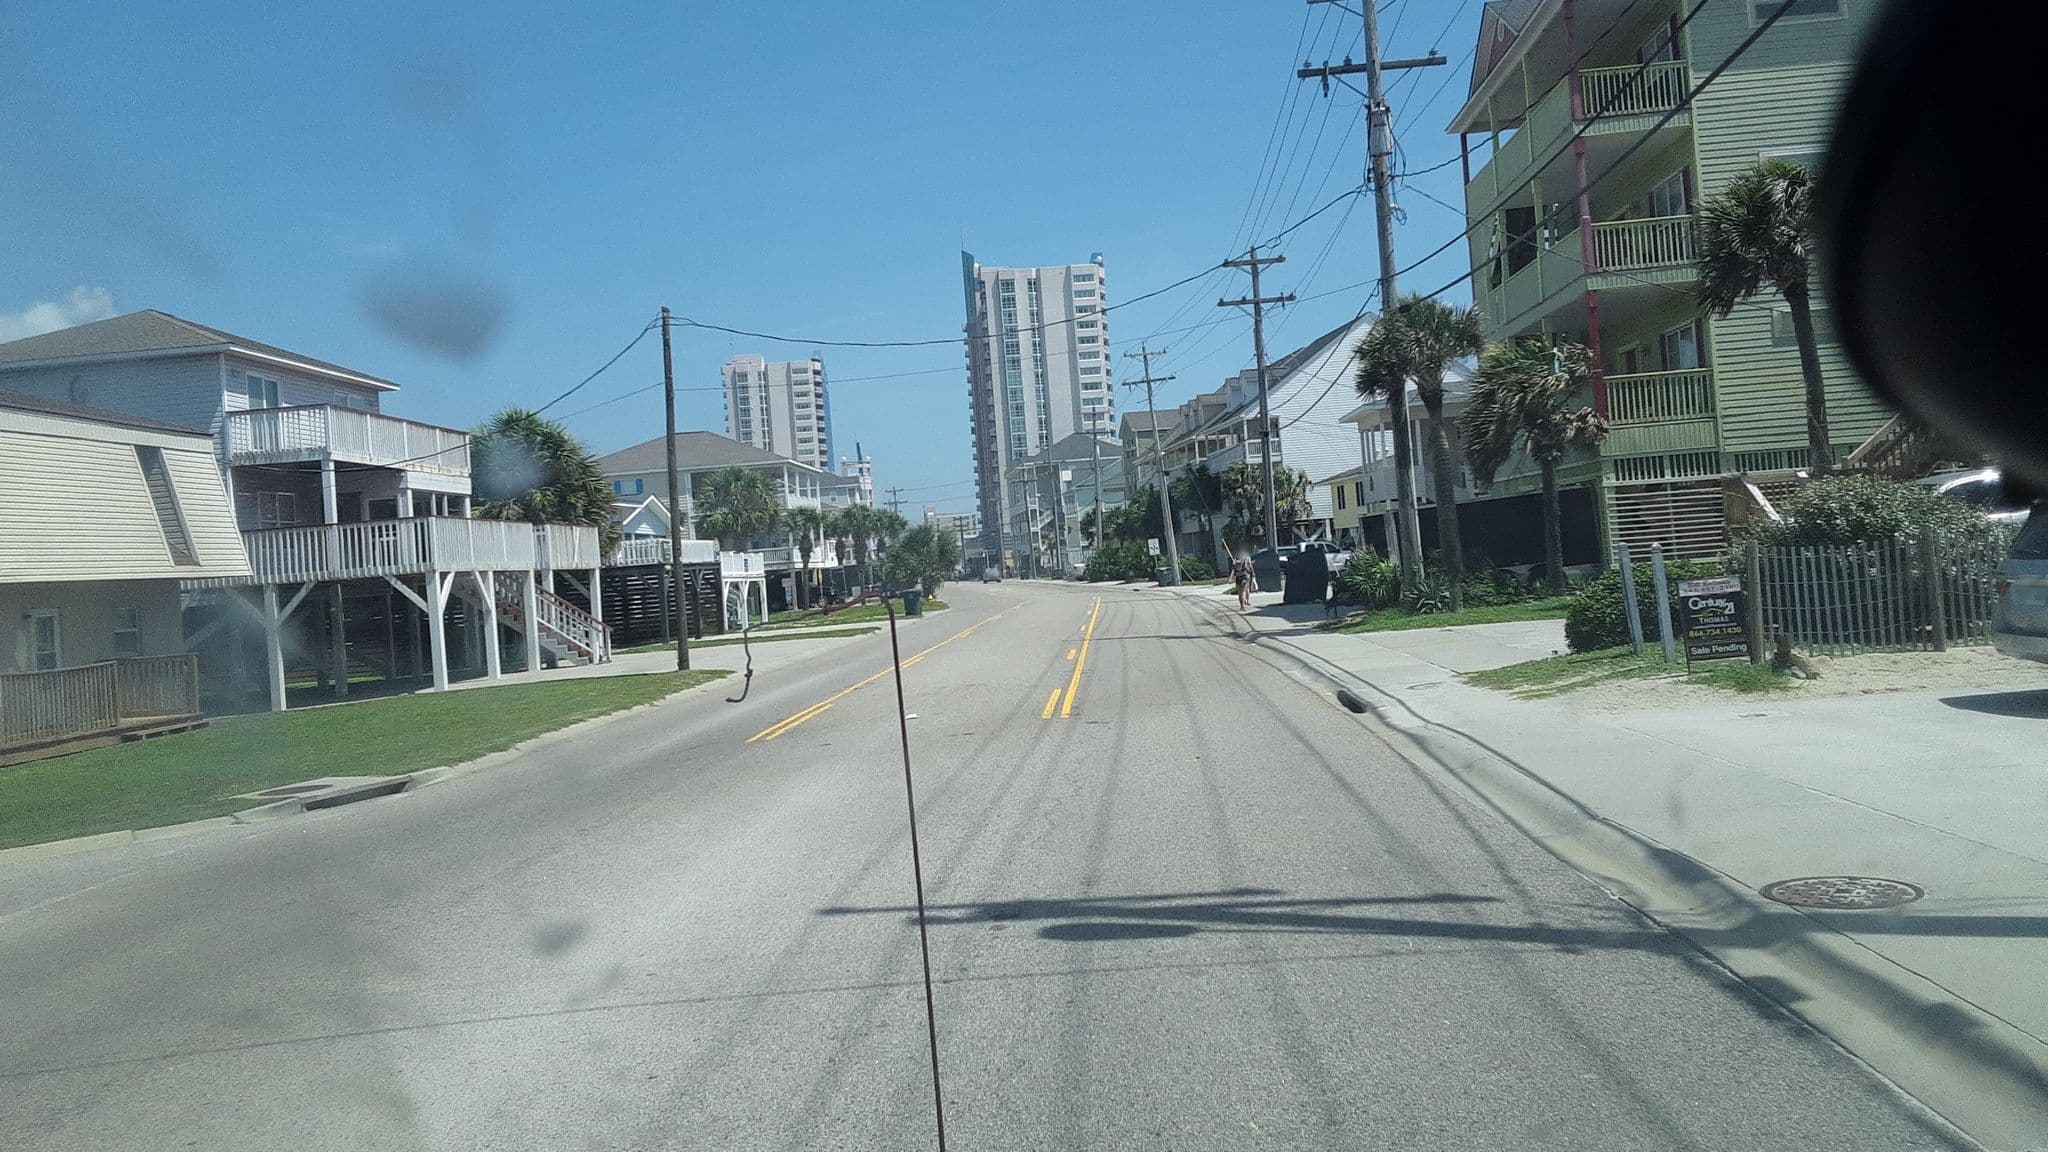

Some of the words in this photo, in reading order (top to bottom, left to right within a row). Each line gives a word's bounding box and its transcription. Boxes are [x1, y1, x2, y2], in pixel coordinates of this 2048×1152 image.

[1688, 597, 1726, 610] Century
[1724, 602, 1735, 614] 21
[1700, 616, 1729, 624] THOMAS
[1689, 626, 1742, 637] 866.734.1430
[1690, 647, 1710, 655] Sale
[1712, 644, 1747, 653] Pending
